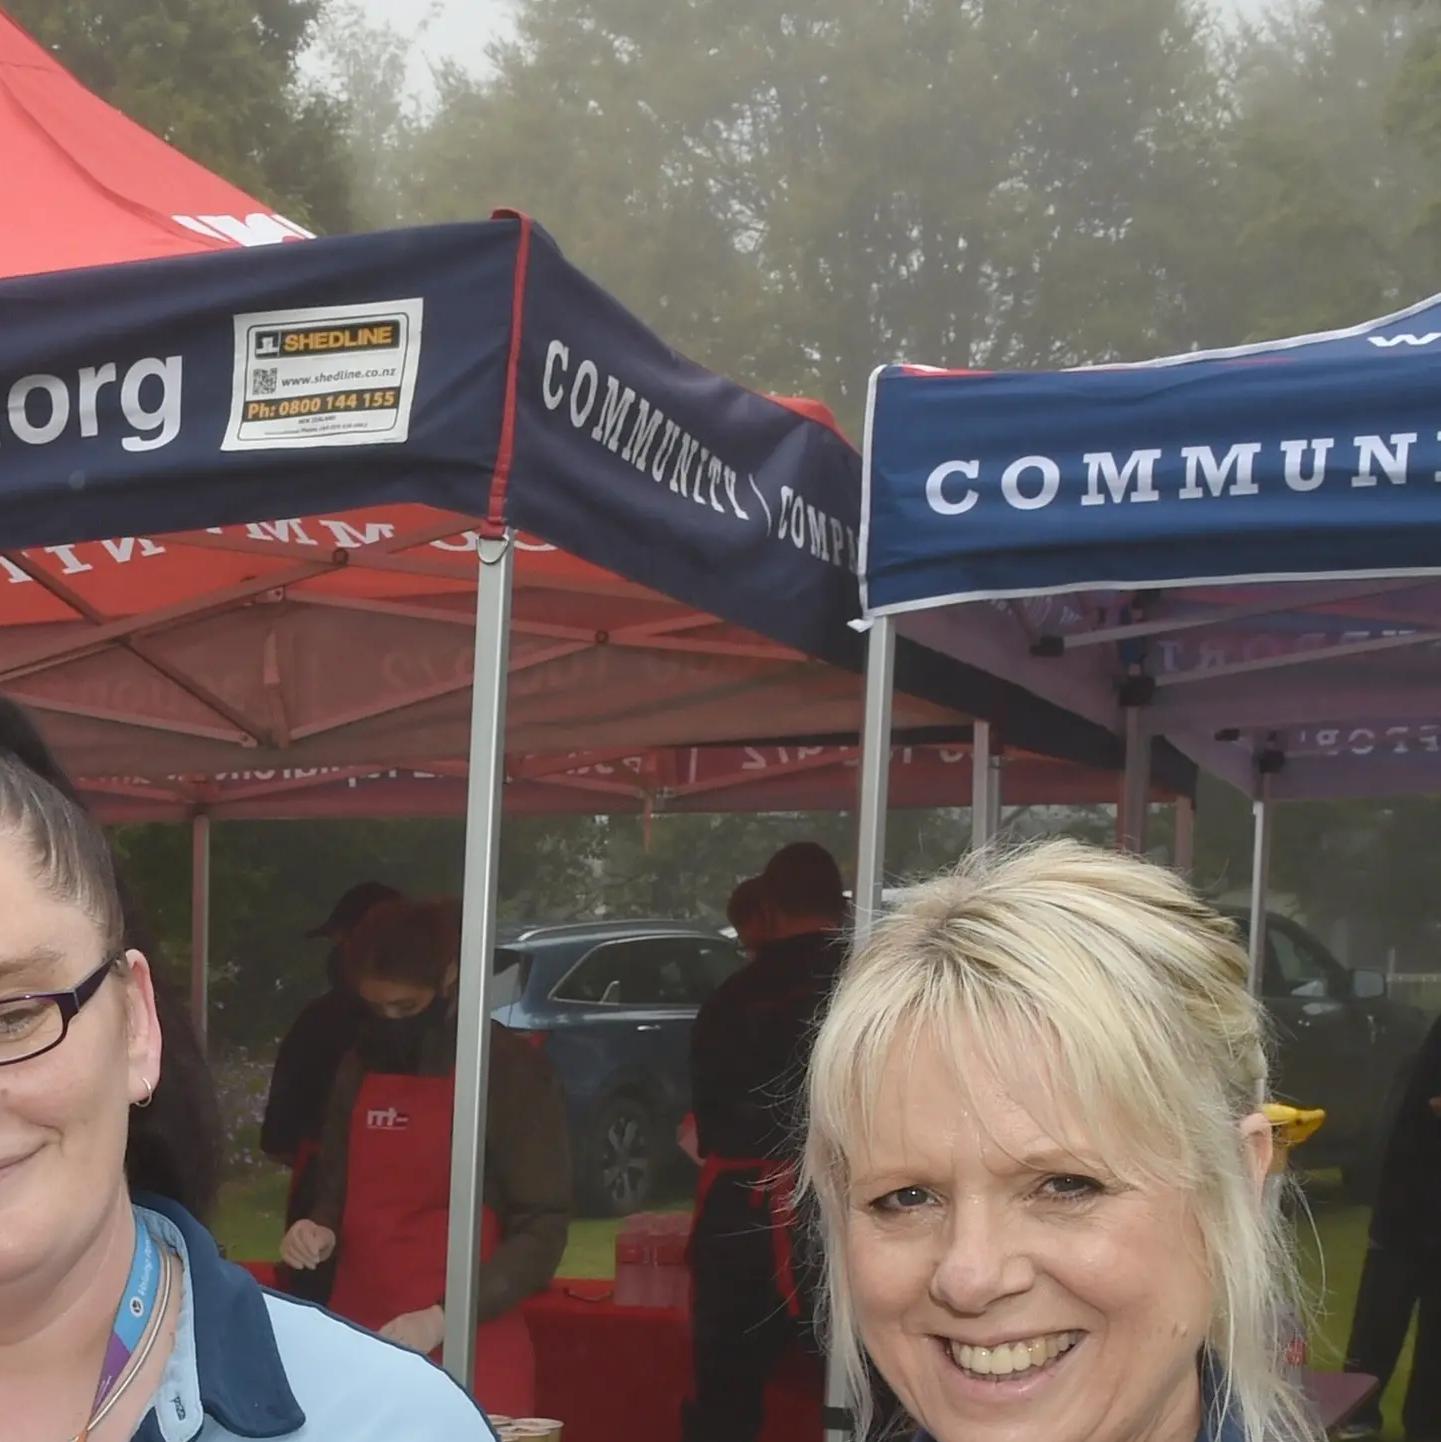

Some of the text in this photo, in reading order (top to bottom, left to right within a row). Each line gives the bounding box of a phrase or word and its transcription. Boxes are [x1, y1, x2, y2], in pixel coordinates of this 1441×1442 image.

[284, 326, 393, 351] SHEDLINE
[281, 366, 397, 387] www.shedline.co.nz
[247, 390, 396, 420] Ph: 0800 144 155
[542, 339, 749, 521] COMMUNITY
[925, 430, 1441, 515] COMMUN
